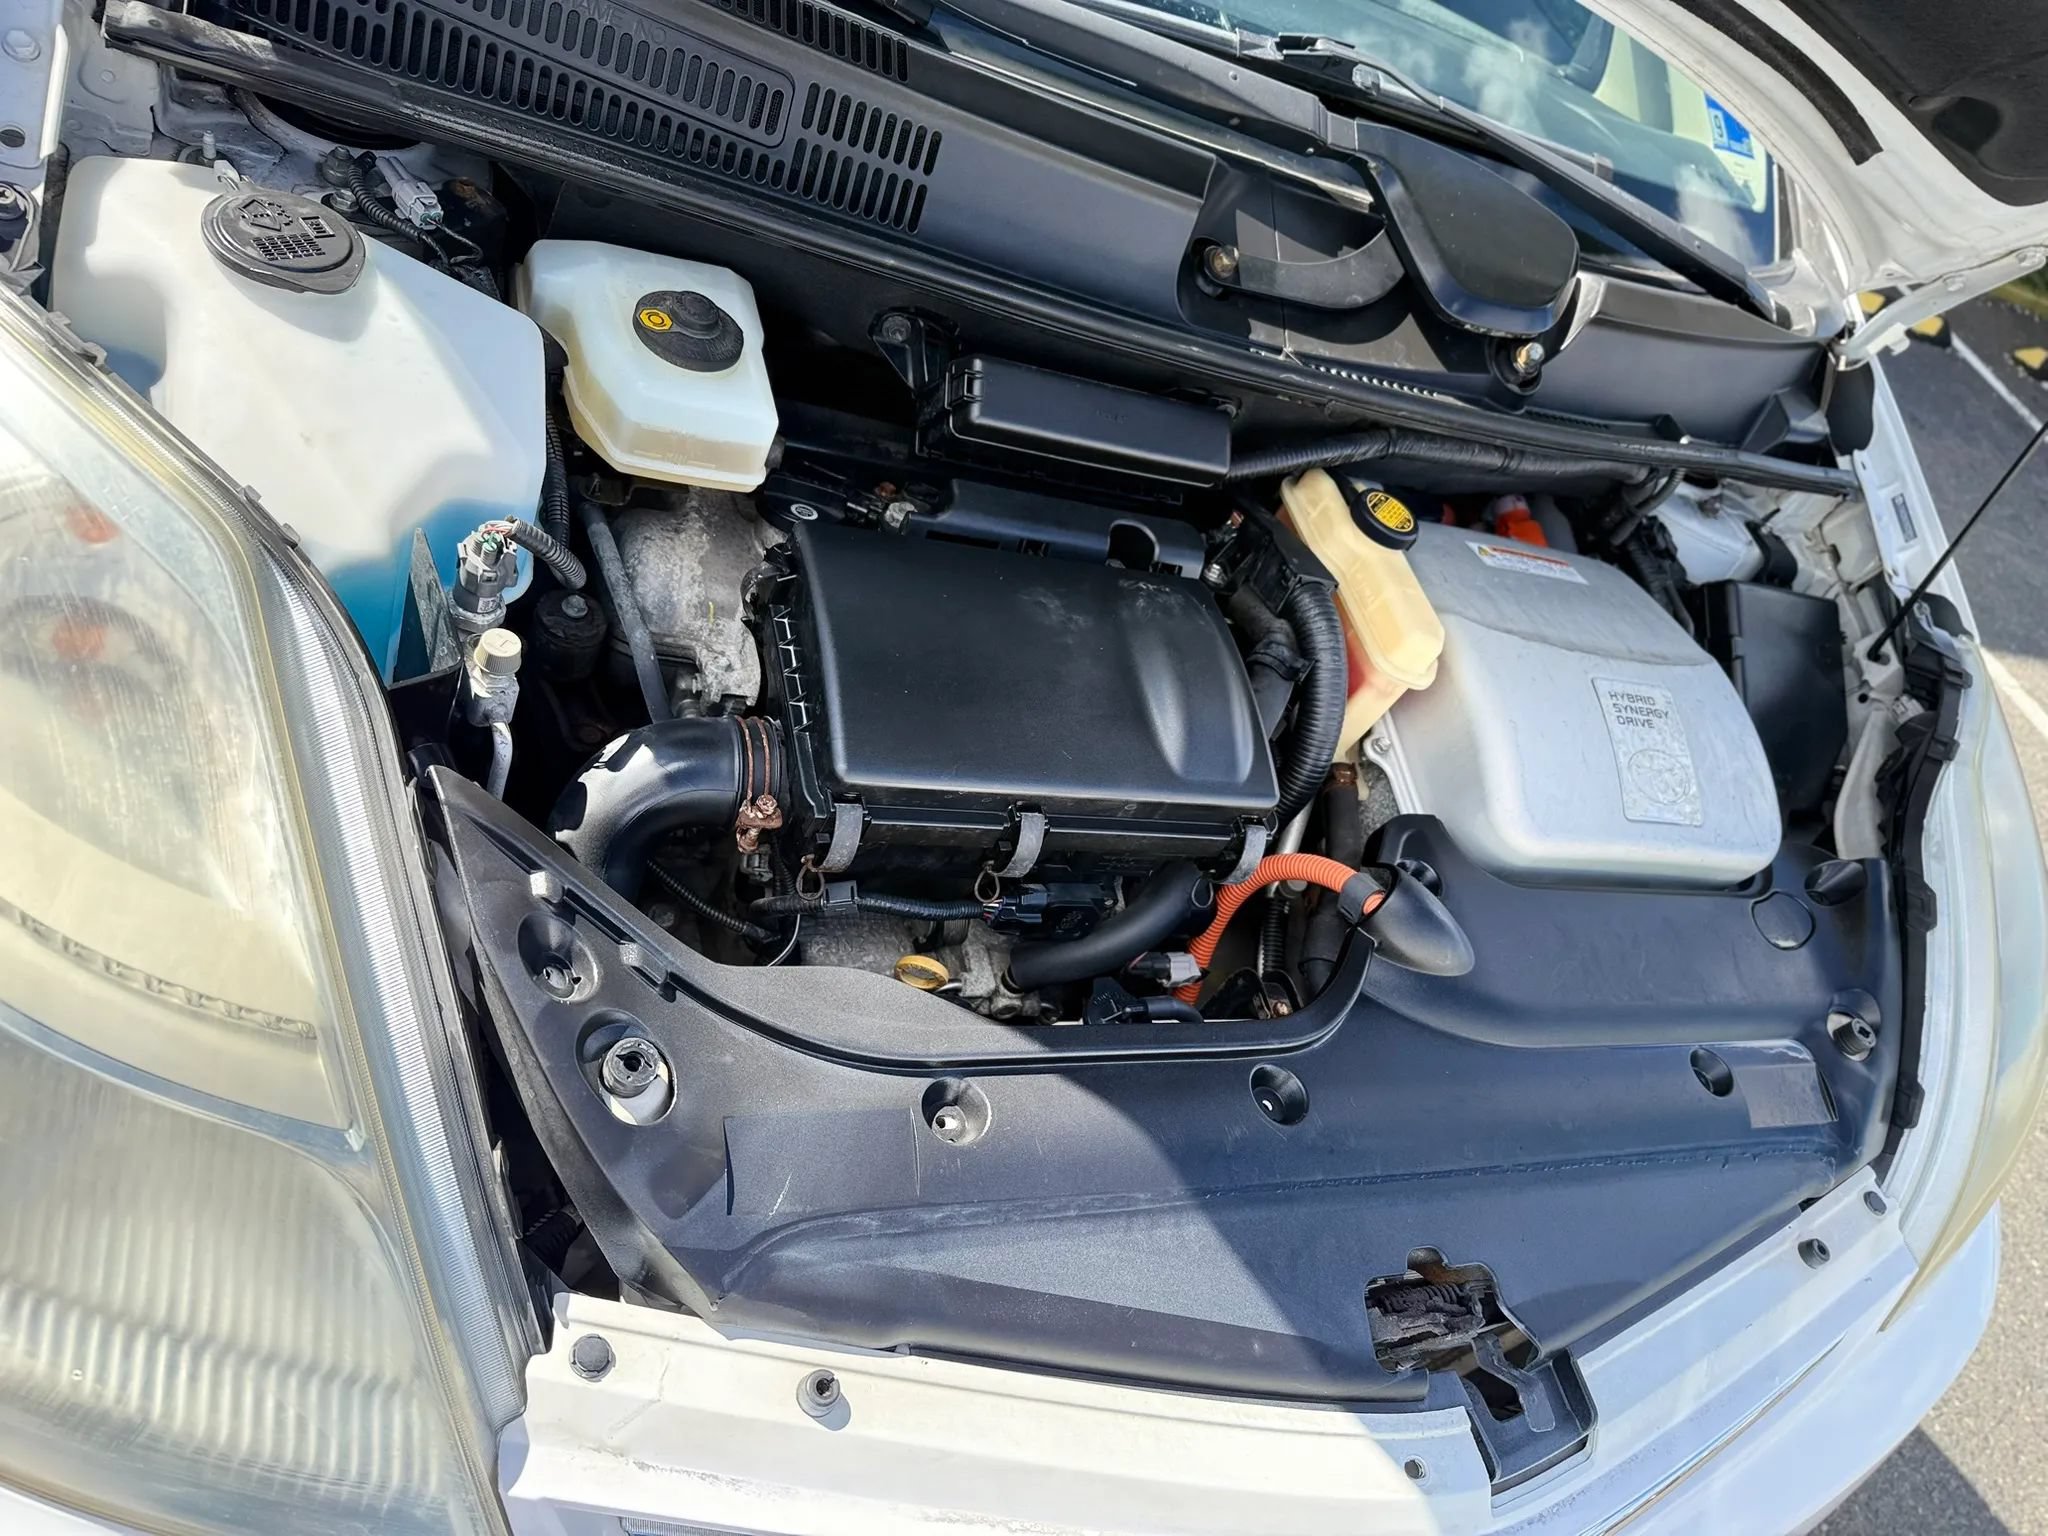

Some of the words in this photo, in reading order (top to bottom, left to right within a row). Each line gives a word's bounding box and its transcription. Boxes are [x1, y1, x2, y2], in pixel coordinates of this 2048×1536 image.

[1608, 690, 1656, 706] HYBRID
[1613, 703, 1669, 720] SYNERGY
[1617, 715, 1655, 729] DRIVE
